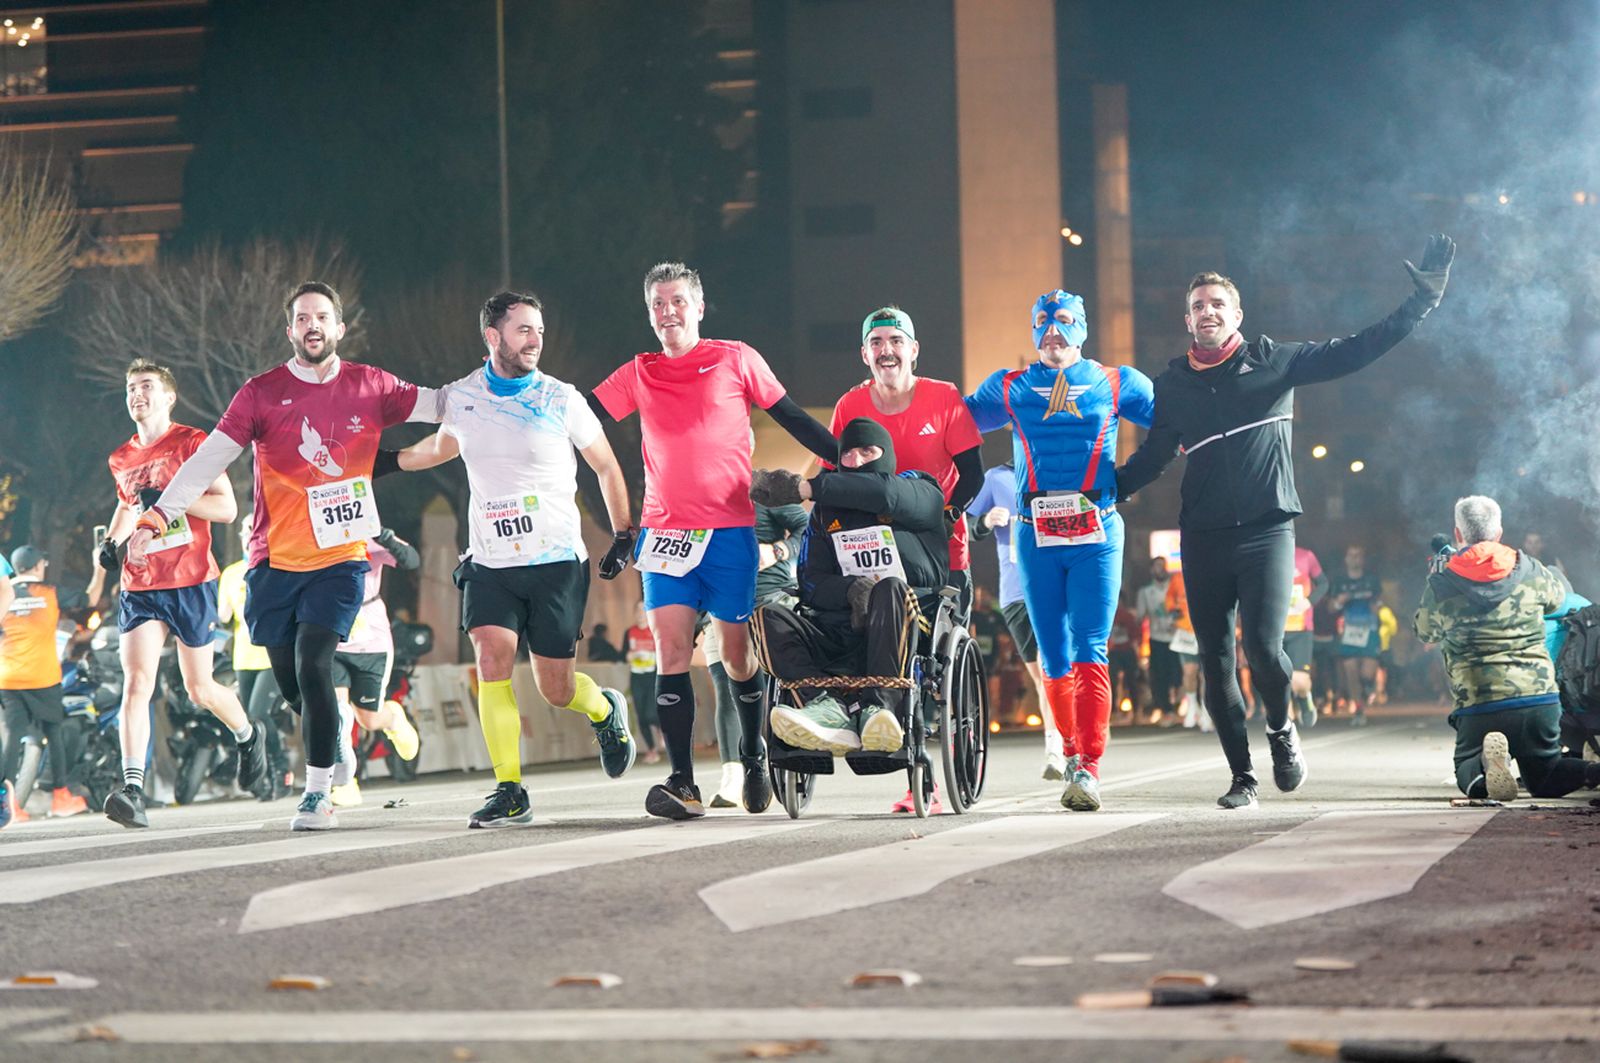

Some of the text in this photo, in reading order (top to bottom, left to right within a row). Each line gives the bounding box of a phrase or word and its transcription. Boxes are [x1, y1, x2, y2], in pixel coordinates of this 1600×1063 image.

[313, 450, 328, 467] 43
[320, 490, 340, 498] NOCHE
[314, 499, 328, 509] SAN
[322, 500, 364, 525] 3152
[492, 502, 508, 510] NOCHE
[493, 515, 533, 537] 1610
[652, 537, 693, 558] 7259
[843, 543, 856, 551] SAN
[852, 547, 893, 568] 1076
